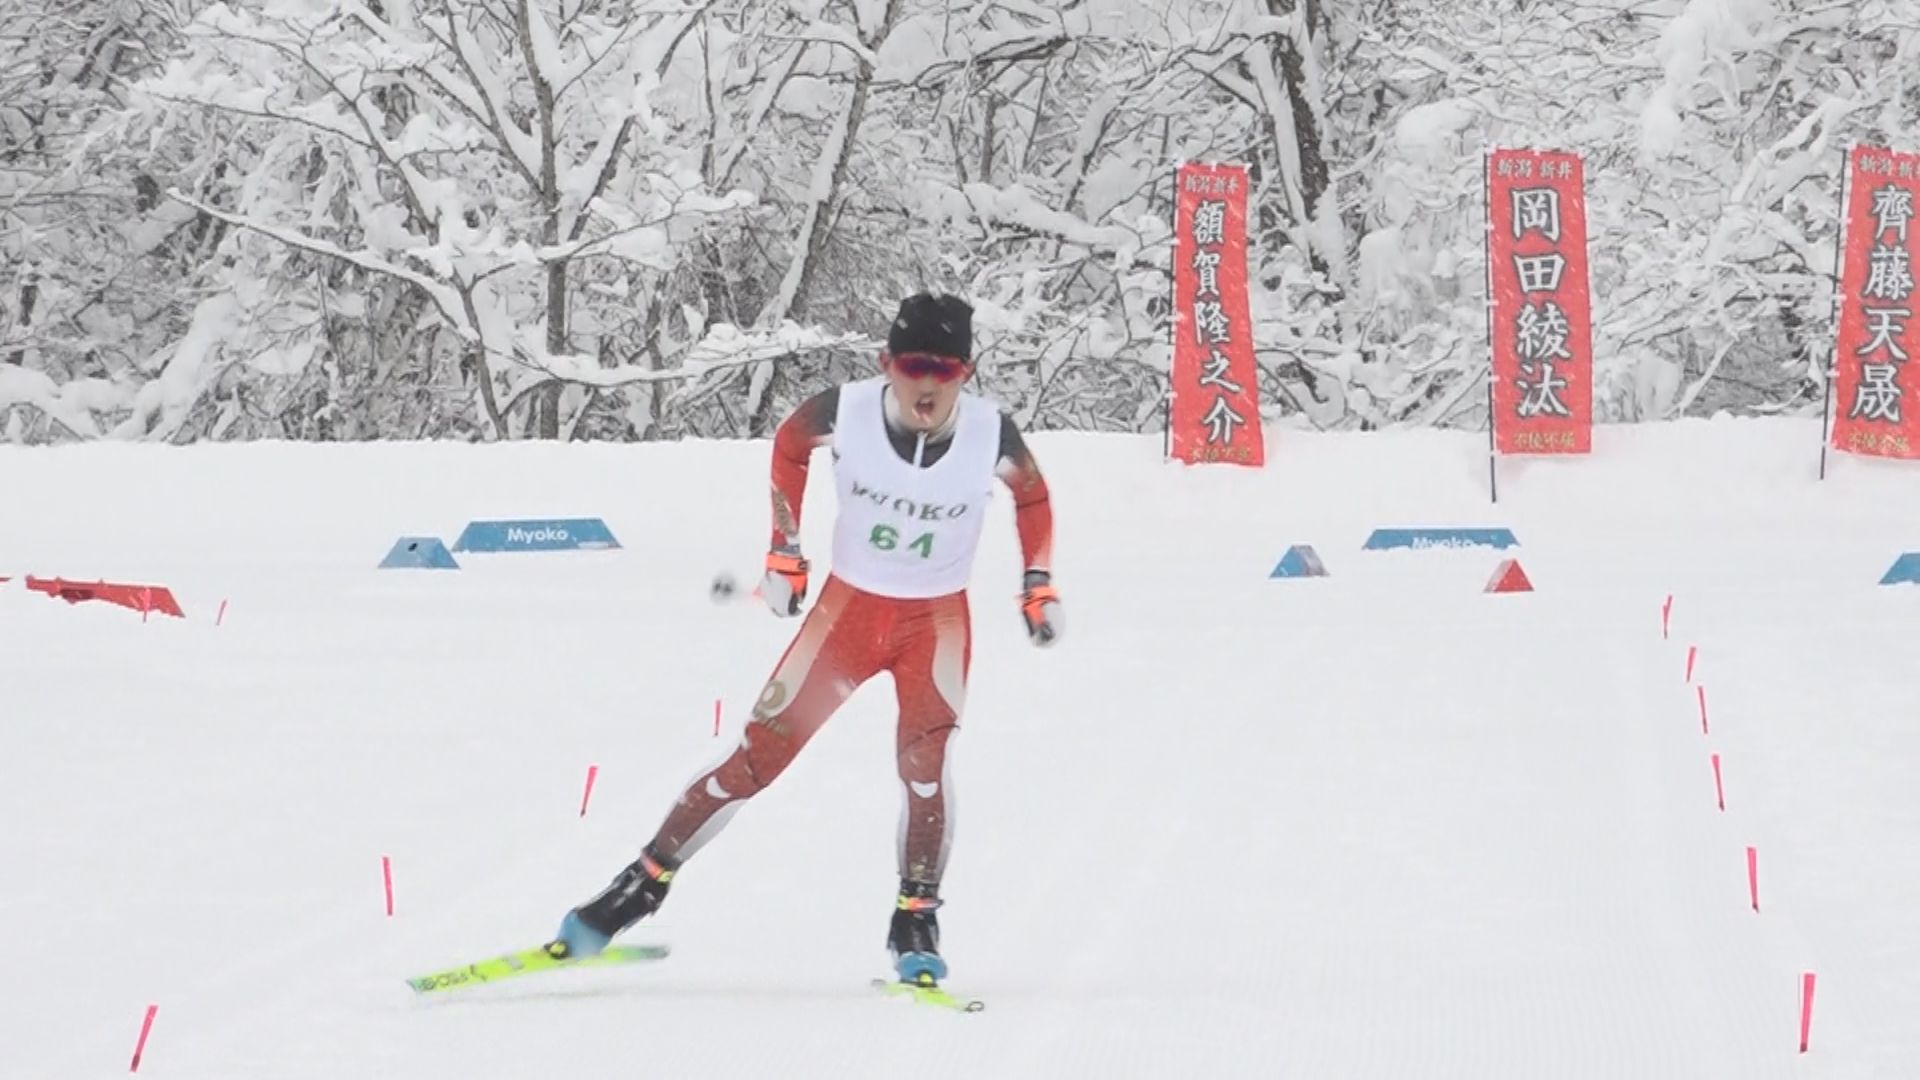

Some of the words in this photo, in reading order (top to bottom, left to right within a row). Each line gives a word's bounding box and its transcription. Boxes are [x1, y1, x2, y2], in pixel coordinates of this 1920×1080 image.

[1191, 200, 1245, 444] 額賀隆之介
[1510, 187, 1573, 417] 岡田綾汰
[1850, 184, 1913, 422] 齊藤天晟
[507, 528, 568, 544] Myoko
[870, 523, 934, 558] 61
